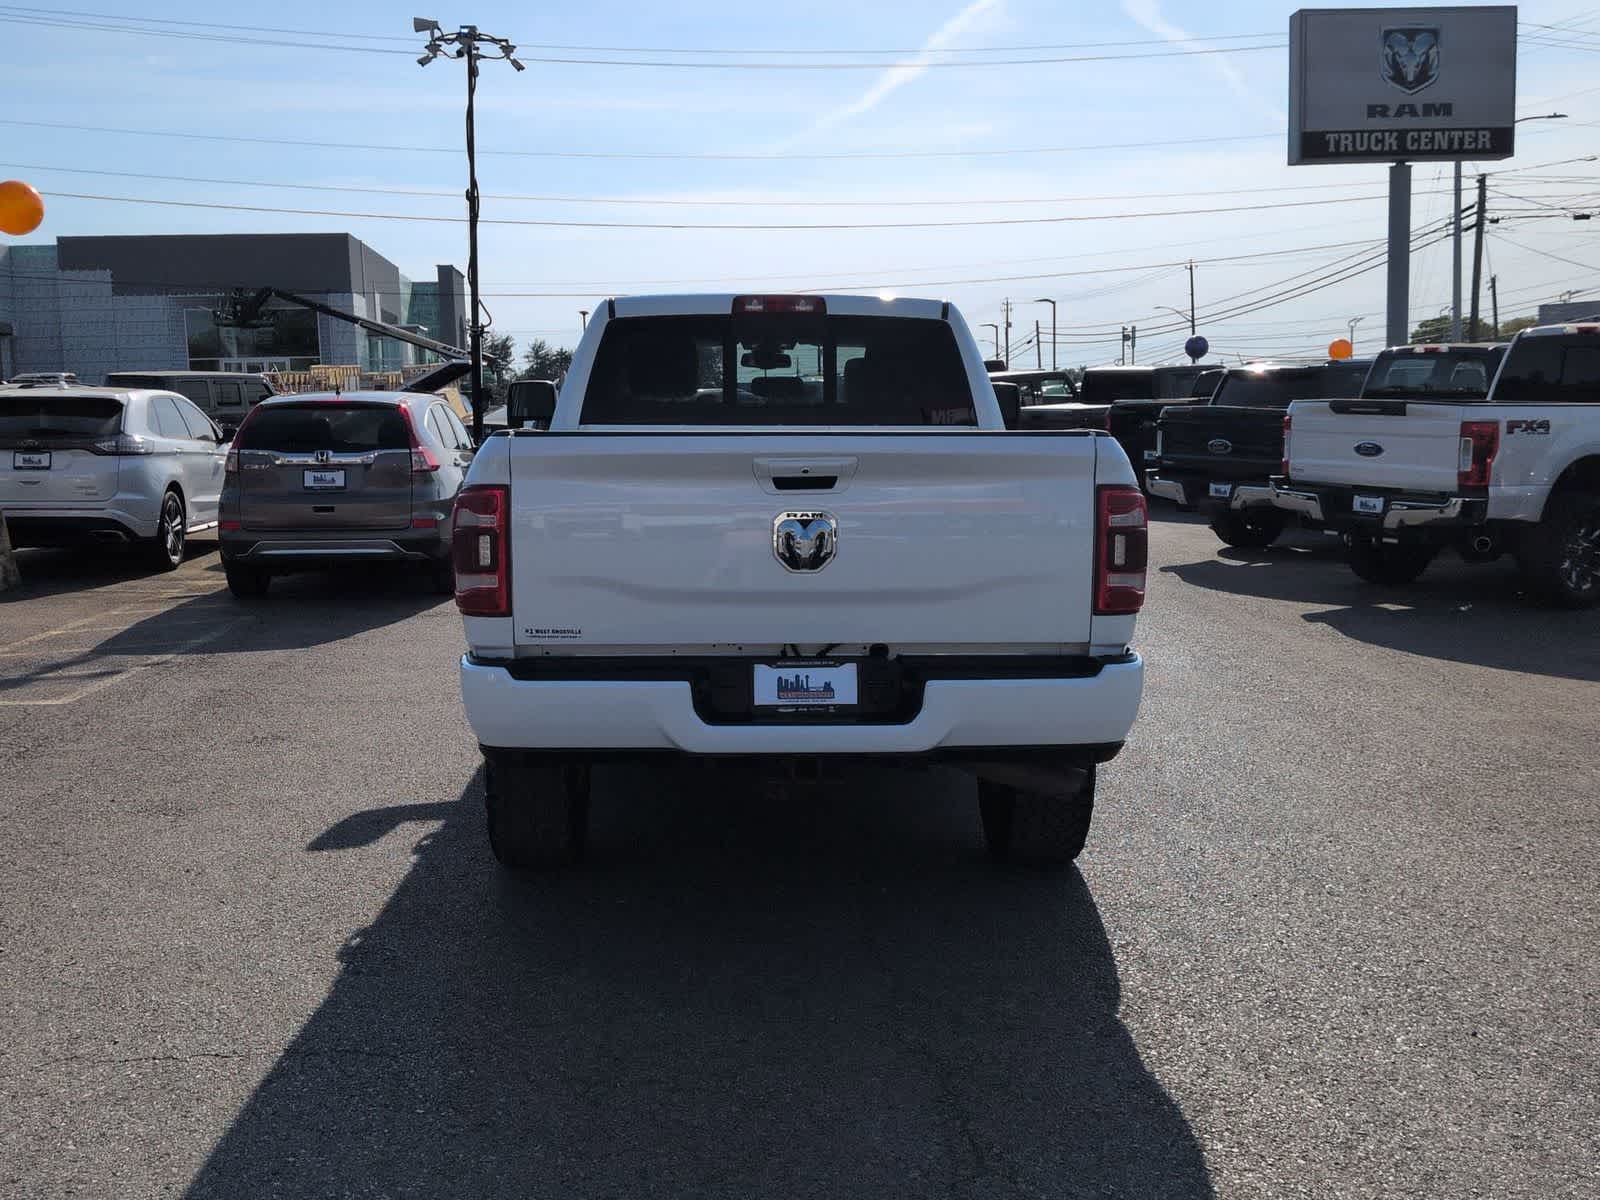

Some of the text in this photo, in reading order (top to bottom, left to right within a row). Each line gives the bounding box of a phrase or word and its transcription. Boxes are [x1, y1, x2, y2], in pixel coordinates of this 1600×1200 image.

[1367, 102, 1453, 118] RAM
[1325, 130, 1492, 152] TRUCK CENTER
[1506, 419, 1550, 434] FX4
